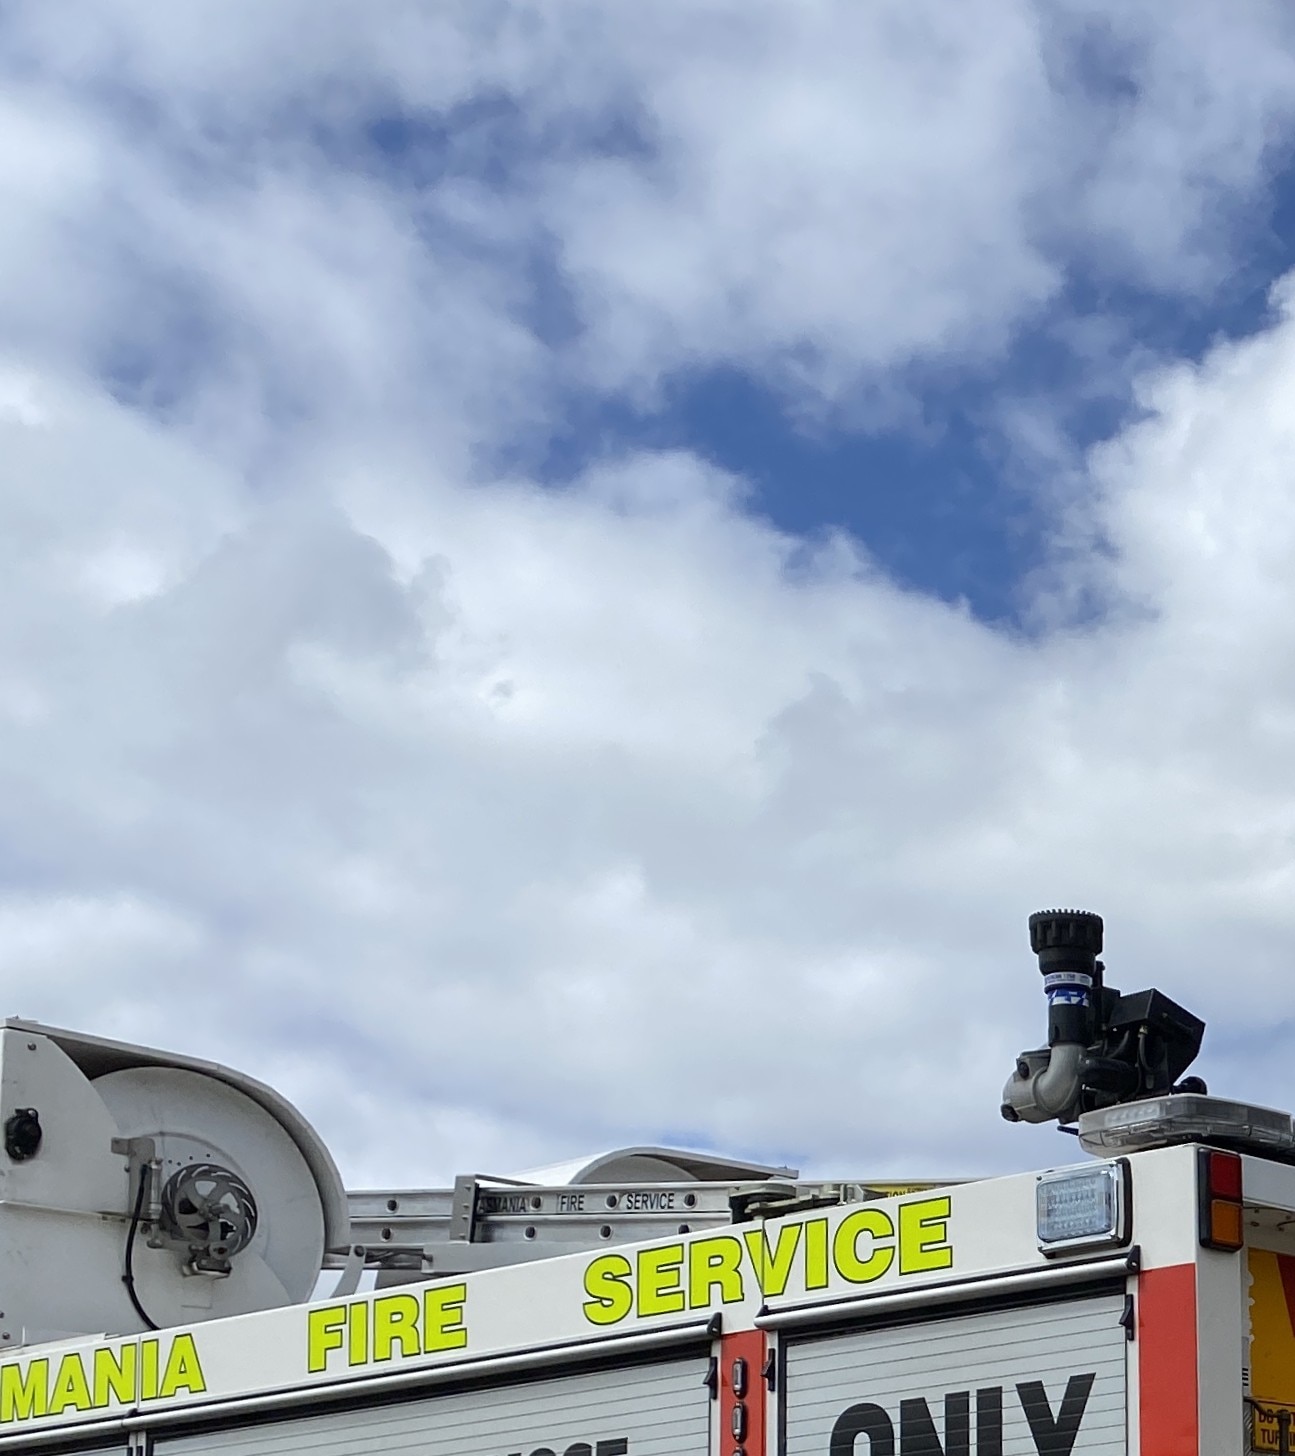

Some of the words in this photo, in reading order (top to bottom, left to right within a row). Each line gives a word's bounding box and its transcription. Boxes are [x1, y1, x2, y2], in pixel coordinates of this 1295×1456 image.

[559, 1194, 585, 1211] FIRE
[626, 1193, 675, 1211] SERVICE
[0, 1333, 206, 1423] MANIA
[308, 1284, 468, 1373] FIRE
[584, 1197, 953, 1325] SERVICE
